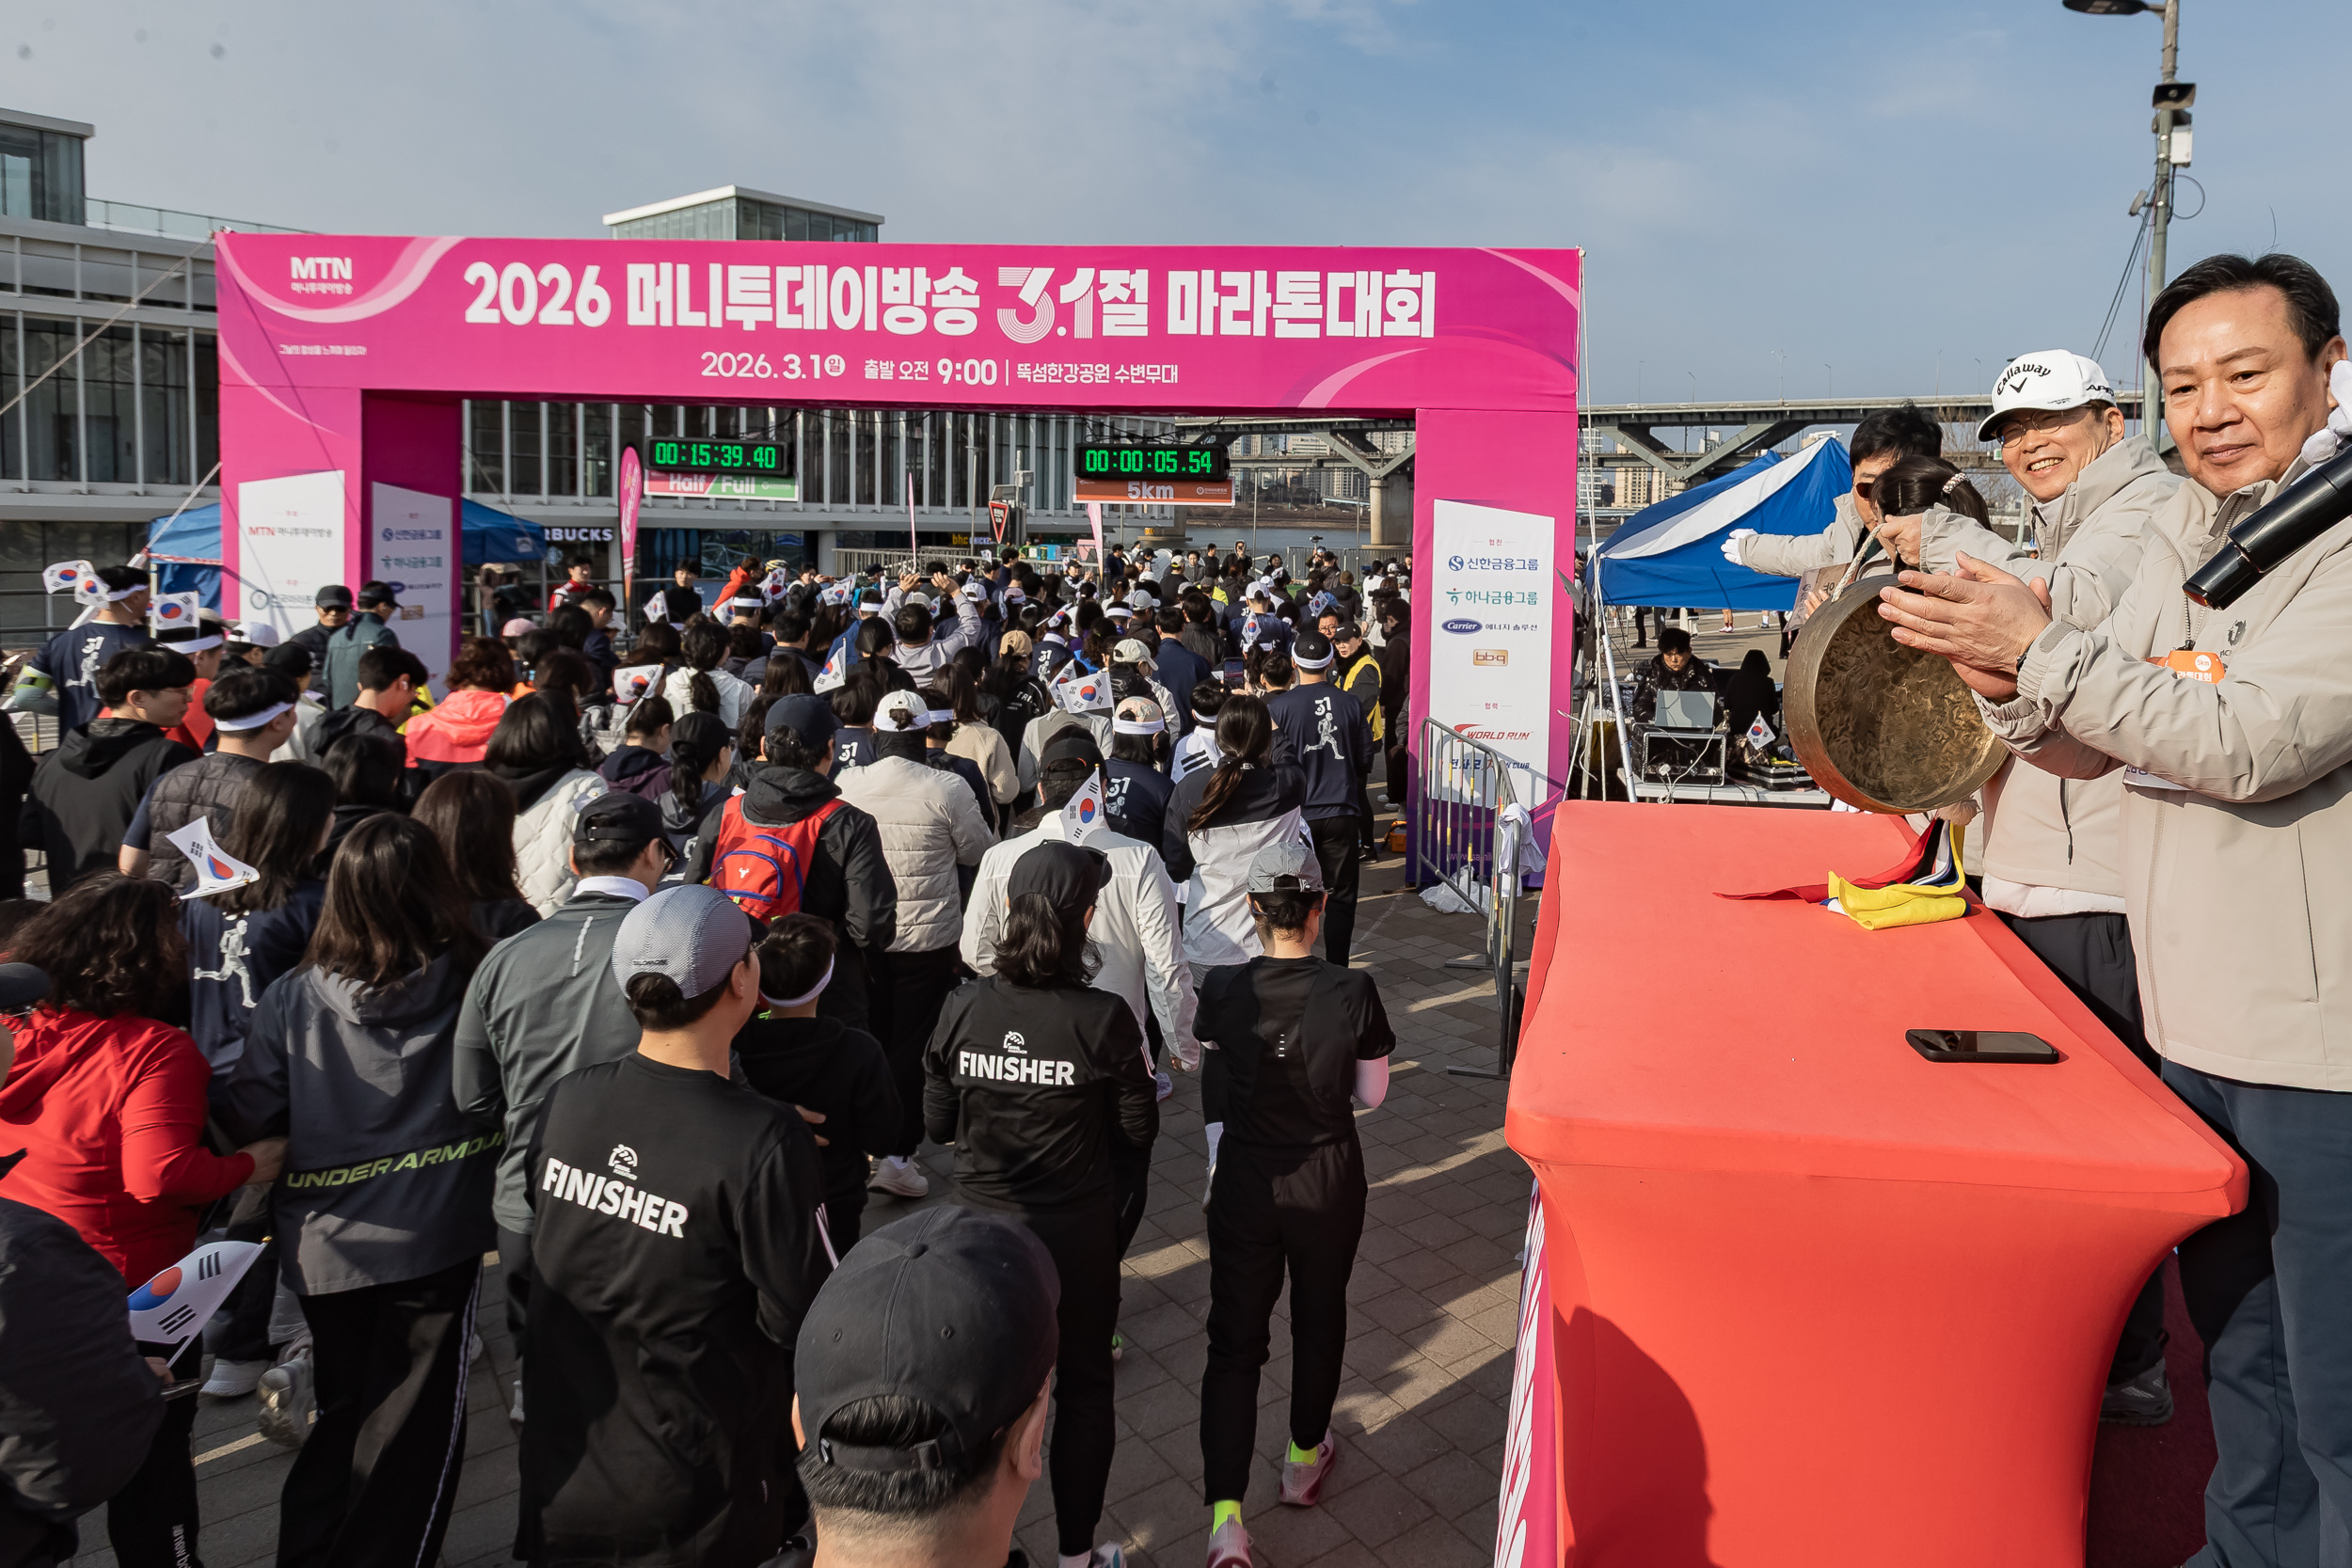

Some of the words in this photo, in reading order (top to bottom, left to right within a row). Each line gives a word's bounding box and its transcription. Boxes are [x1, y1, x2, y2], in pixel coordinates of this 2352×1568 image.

[290, 256, 353, 279] MTN
[463, 261, 612, 327] 2026
[627, 262, 978, 337] 머니투데이방송
[997, 266, 1150, 344] 3.1절
[1167, 269, 1436, 339] 마라톤대회
[864, 359, 896, 381] 출발
[898, 360, 930, 381] 오전
[937, 357, 997, 386] 9:00
[1016, 362, 1111, 384] 뚝섬한강공원
[1114, 364, 1179, 384] 수변무대
[1996, 363, 2052, 396] Callaway
[1085, 450, 1212, 473] 00:00:05.54
[669, 473, 706, 492] Half
[721, 476, 755, 494] Full
[1127, 482, 1174, 499] 5km
[1468, 558, 1539, 571] 신한금융그룹
[1466, 591, 1538, 606] 하나금융그룹
[1447, 622, 1478, 631] Carrier
[2197, 658, 2210, 667] 5km
[1467, 731, 1505, 740] WORLD
[1505, 732, 1531, 741] RUN
[959, 1050, 1075, 1085] FINISHER
[287, 1157, 393, 1188] UNDER
[542, 1157, 689, 1239] FINISHER
